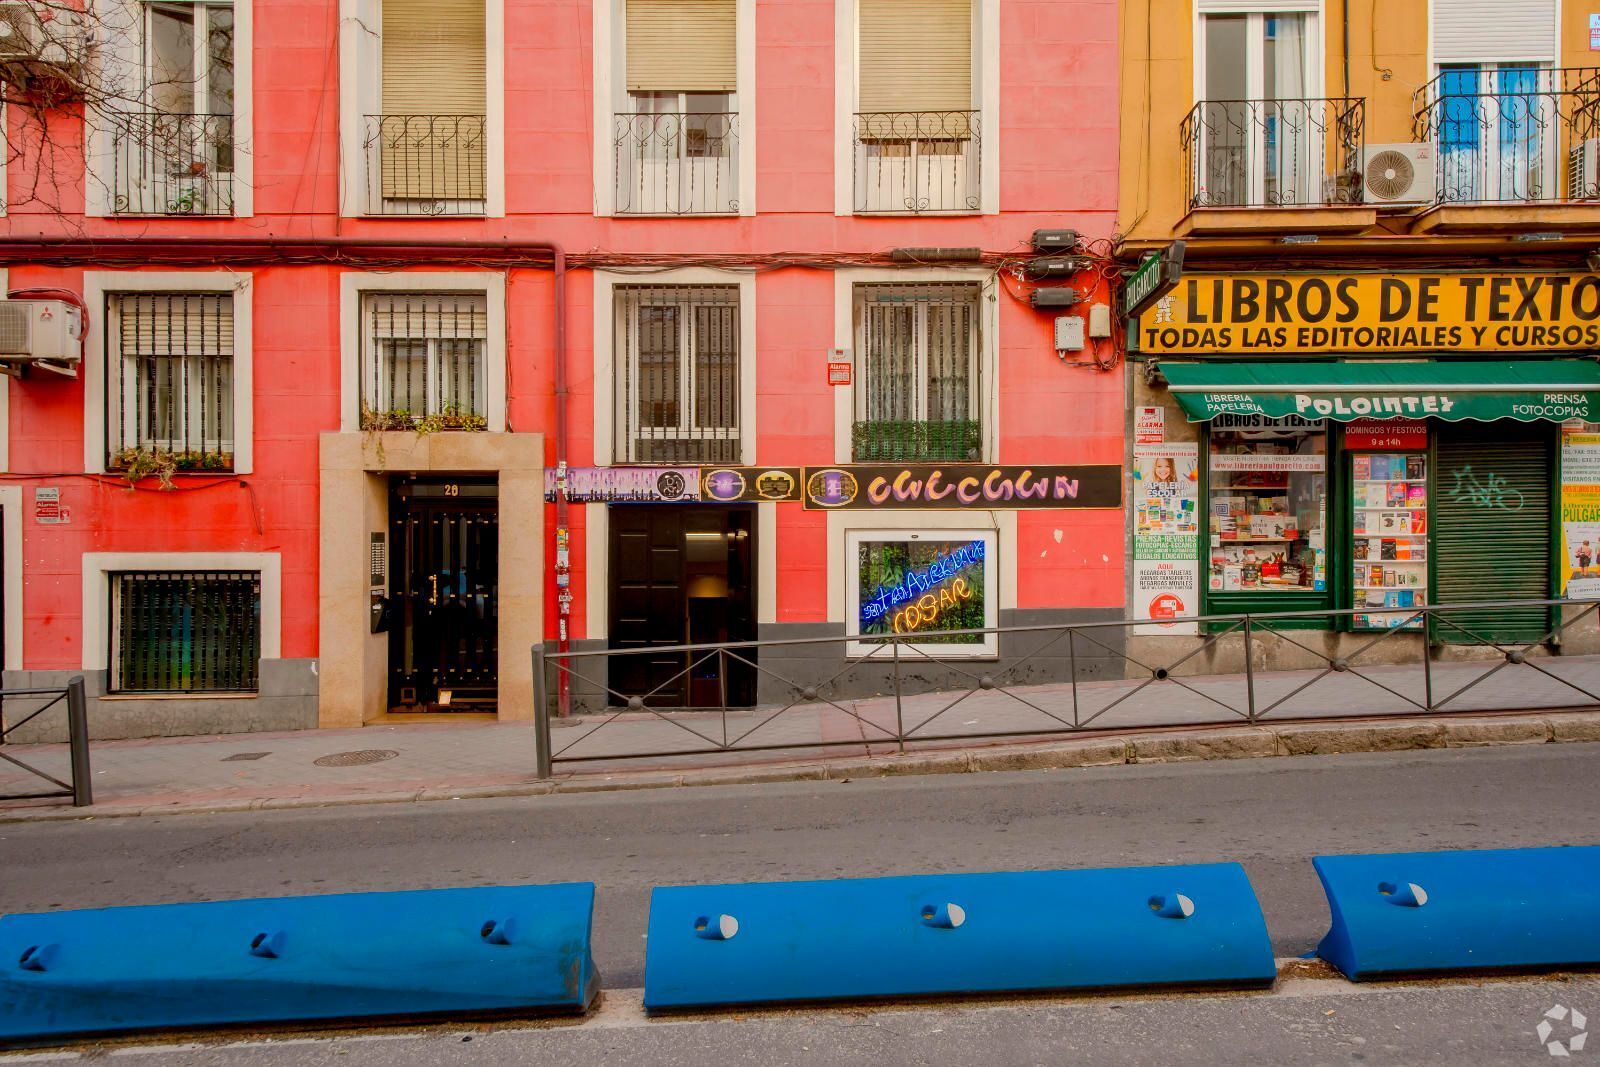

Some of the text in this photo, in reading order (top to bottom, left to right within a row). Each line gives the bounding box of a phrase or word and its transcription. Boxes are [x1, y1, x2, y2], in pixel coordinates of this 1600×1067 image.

[1187, 276, 1600, 324] LIBROS DE TEXTO
[1146, 325, 1599, 349] TODAS LAS EDITORIALES Y CURSOS
[1204, 394, 1253, 403] LIBRERIA
[1543, 394, 1588, 404] PRENSA
[1207, 403, 1264, 413] PAPELERIA
[1512, 404, 1589, 417] FOTOCOPIAS
[1345, 426, 1427, 434] DOMINGOS Y FESTIVOS
[1371, 438, 1377, 447] 9
[1386, 438, 1401, 447] 14h
